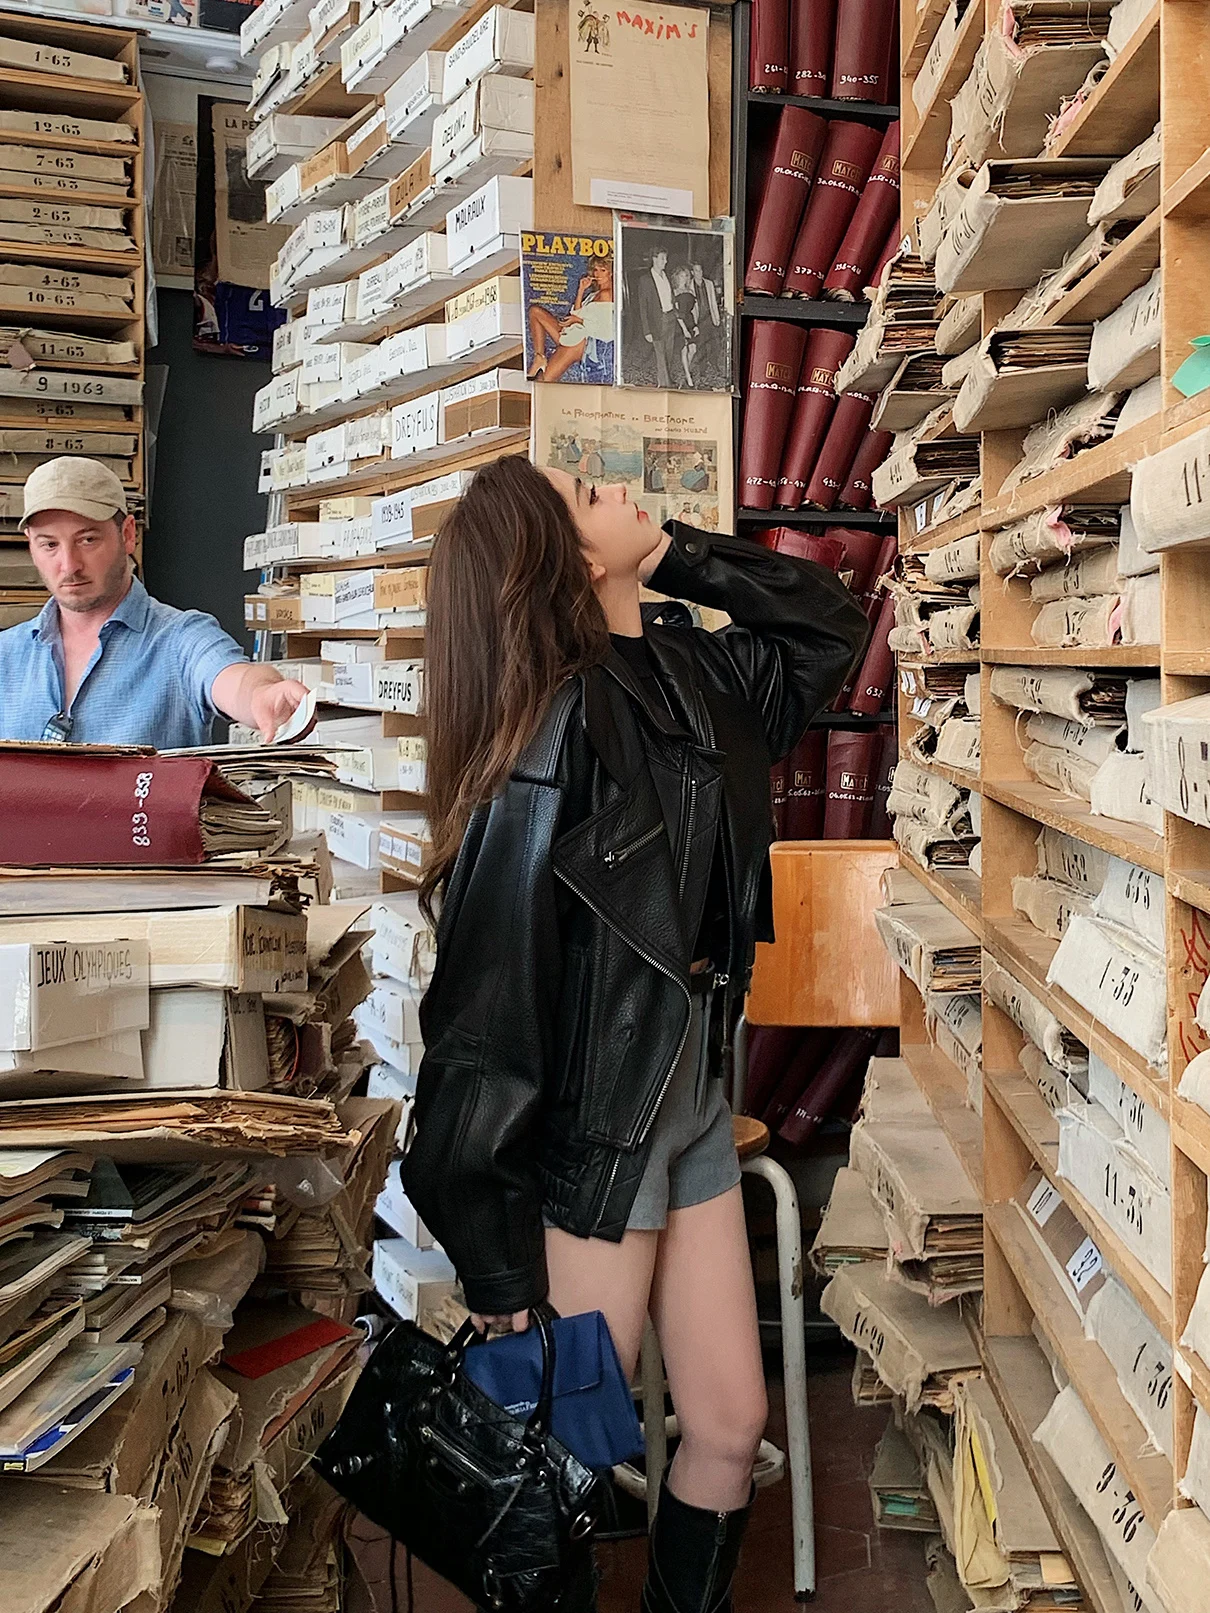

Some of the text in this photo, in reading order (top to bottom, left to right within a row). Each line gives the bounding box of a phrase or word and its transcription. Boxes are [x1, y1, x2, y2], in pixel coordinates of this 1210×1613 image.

[34, 50, 71, 67] 1-63
[34, 120, 81, 136] 12-63
[225, 118, 238, 129] LA
[36, 154, 74, 169] 7-63
[395, 172, 414, 206] ZOLA
[32, 207, 71, 222] 2-63
[455, 195, 486, 233] MALRAUX
[41, 274, 80, 288] 4-63
[27, 291, 75, 306] 10-63
[40, 343, 84, 357] 11-63
[63, 381, 104, 396] 1963
[396, 404, 435, 442] DREYFUS
[561, 408, 572, 416] LA
[643, 414, 695, 425] BRETAGNE
[45, 438, 84, 450] 8-63
[378, 680, 412, 702] DREYFUS
[37, 947, 68, 988] JEUX
[1096, 1461, 1145, 1543] 9-36
